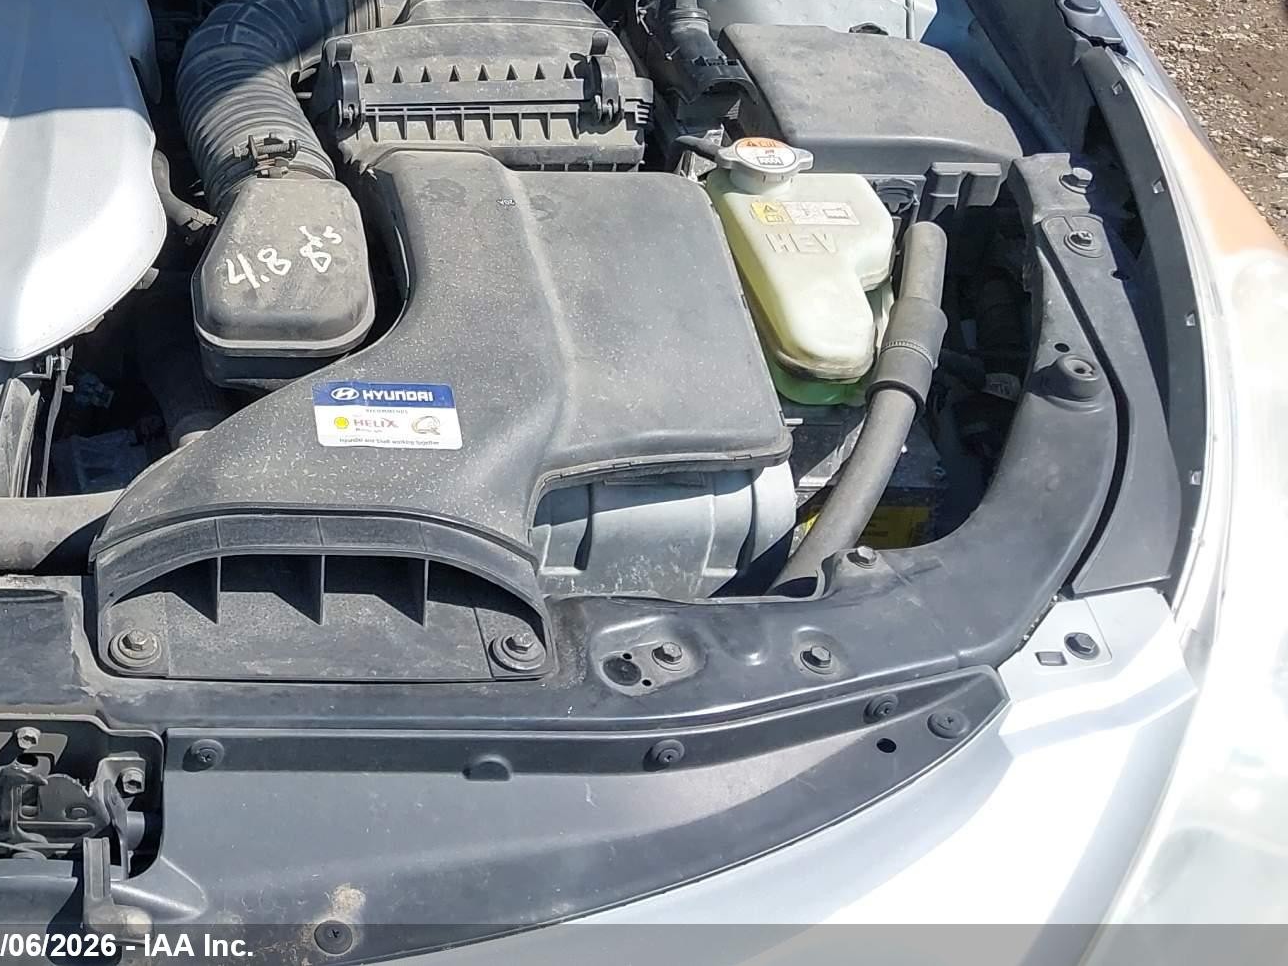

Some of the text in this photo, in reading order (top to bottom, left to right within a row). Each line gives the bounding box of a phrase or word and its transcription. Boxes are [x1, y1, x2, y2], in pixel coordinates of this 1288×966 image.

[766, 233, 837, 253] HEV
[226, 248, 291, 288] 4.8
[362, 389, 433, 402] HYUNDAI
